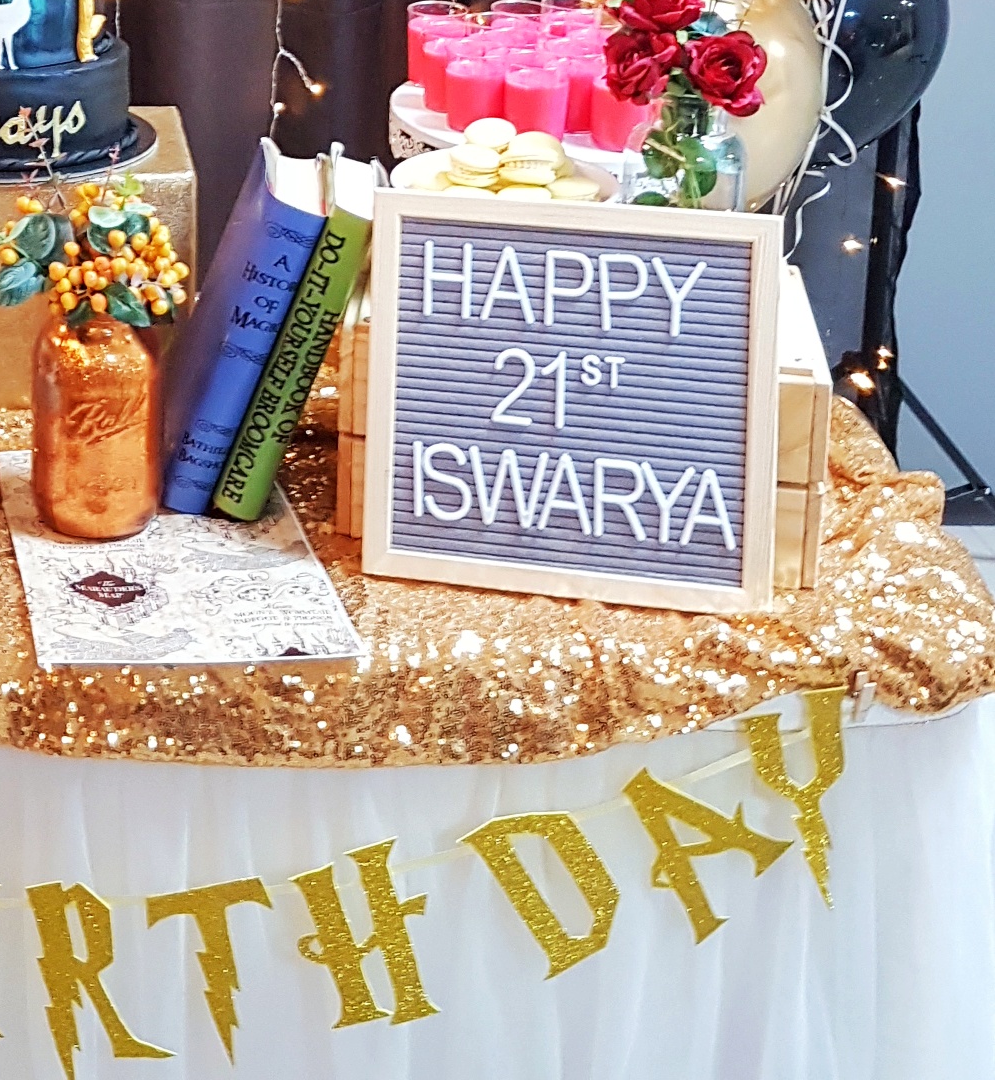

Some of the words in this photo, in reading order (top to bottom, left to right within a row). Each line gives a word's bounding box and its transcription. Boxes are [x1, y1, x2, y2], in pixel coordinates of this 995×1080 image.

[254, 296, 280, 314] OF
[268, 230, 346, 390] DO-IT-YOURSELF
[273, 255, 292, 273] A
[421, 240, 708, 338] HAPPY
[281, 309, 342, 414] HANDBOOK
[222, 386, 281, 504] BROOMCARE
[271, 419, 295, 443] OF
[412, 440, 738, 551] ISWARYA
